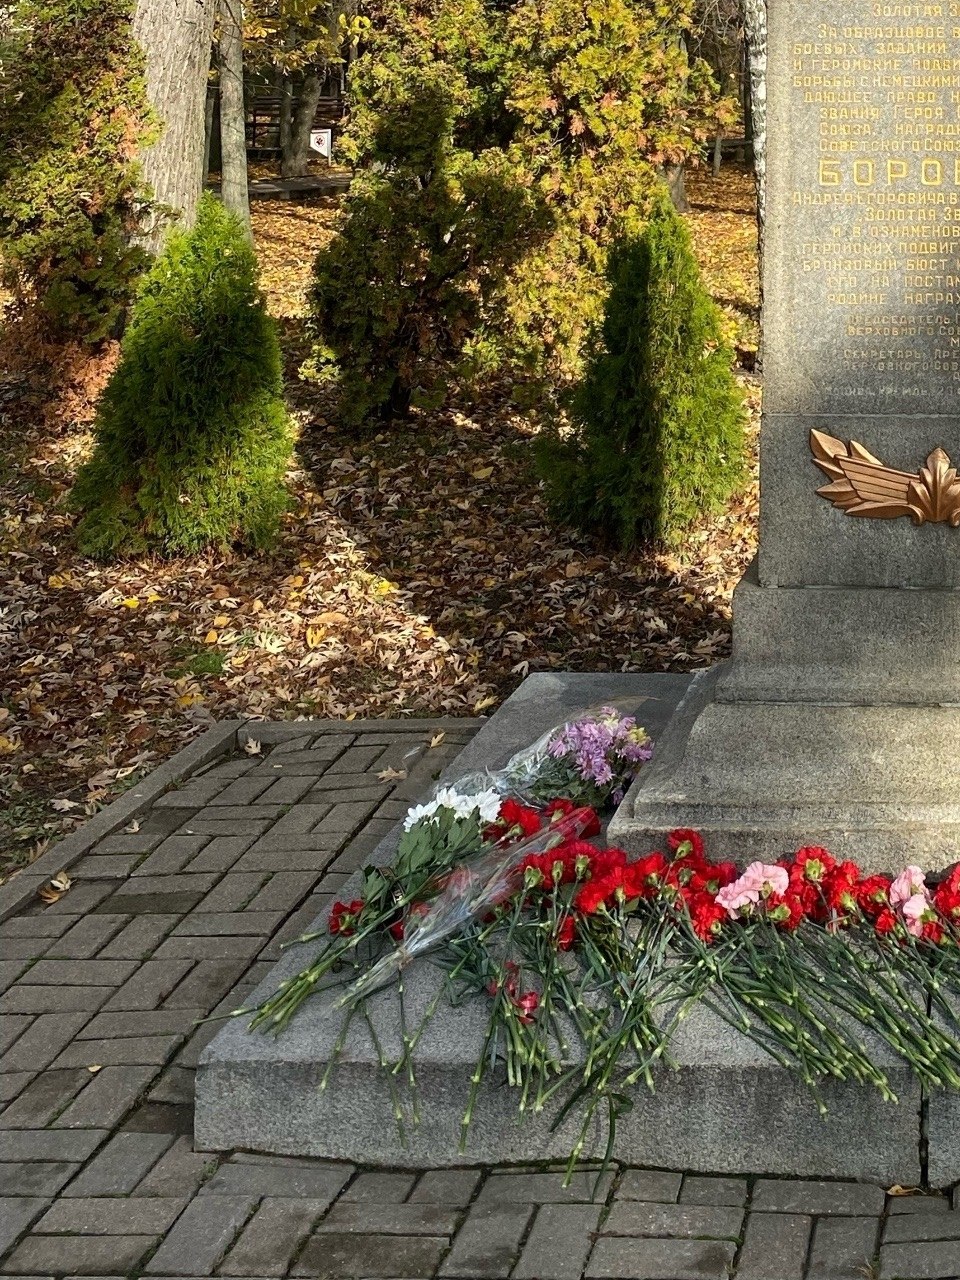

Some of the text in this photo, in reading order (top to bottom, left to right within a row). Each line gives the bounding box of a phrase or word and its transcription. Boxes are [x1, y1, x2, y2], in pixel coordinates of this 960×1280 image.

[873, 3, 942, 17] ЗОЛОТАЯ
[818, 23, 836, 38] ЗА
[843, 26, 945, 38] ОБРАЗЦОВОЕ
[793, 43, 858, 55] БОЕВЫХ
[793, 59, 802, 70] И
[793, 75, 855, 87] БОРЬБЫ
[860, 75, 869, 86] С
[873, 75, 960, 87] НЕМЕЦКИМИ
[805, 91, 871, 102] ДАЮЩЕЕ
[887, 91, 936, 102] ПРАВО
[820, 107, 880, 119] ЗВАНИЯ
[894, 106, 943, 119] ГЕРОЯ
[819, 139, 920, 152] СОВЕТСКОГО
[793, 192, 853, 204] АНДРЕЯ
[857, 192, 945, 204] ЕГОРОВИЧА
[832, 226, 841, 237] И
[854, 226, 861, 237] В
[906, 259, 947, 271] БЮСТ
[872, 276, 890, 287] НА
[828, 293, 887, 305] РОДИНЕ
[847, 326, 933, 336] ВЕРХОВНОГО
